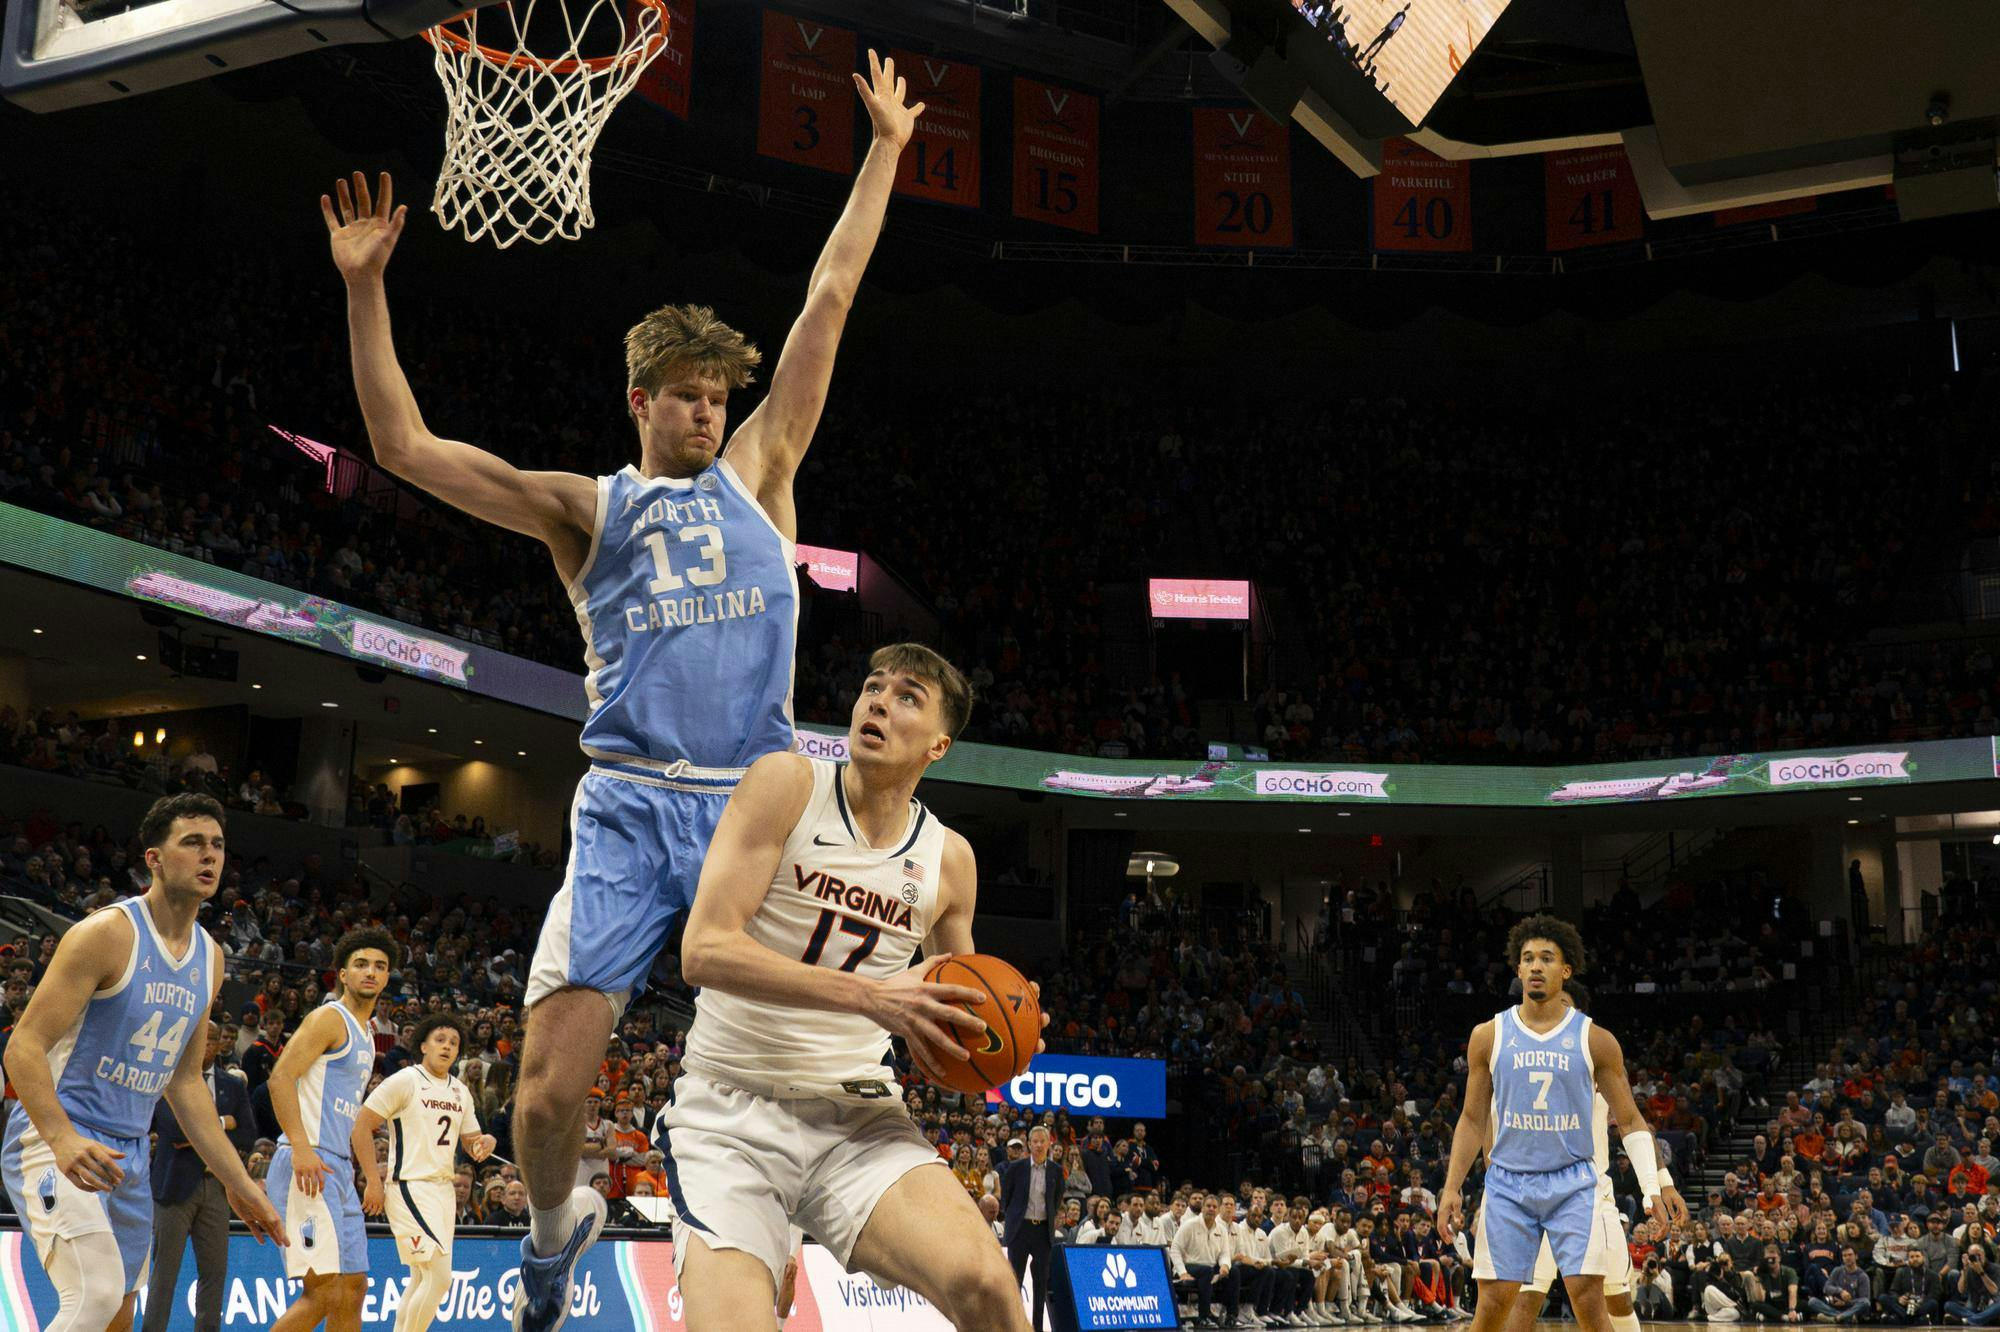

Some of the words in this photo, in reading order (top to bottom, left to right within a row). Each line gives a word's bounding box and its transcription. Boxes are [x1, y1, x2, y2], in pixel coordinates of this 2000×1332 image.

[791, 83, 826, 101] LAMP
[794, 106, 819, 151] 3
[914, 119, 969, 141] ILKINSON
[912, 140, 959, 192] 14
[1029, 144, 1086, 168] BROGDON
[1033, 166, 1076, 214] 15
[1223, 172, 1262, 184] STITH
[1391, 176, 1454, 190] PARKHILL
[1567, 168, 1617, 185] WALKER
[1216, 191, 1273, 234] 20
[1391, 196, 1452, 240] 40
[1567, 190, 1615, 234] 41
[628, 498, 725, 538] NORTH
[643, 524, 727, 595] 13
[819, 562, 852, 577] Teeter
[625, 586, 767, 632] CAROLINA
[1174, 593, 1207, 604] Harris
[1208, 594, 1244, 605] Teeter
[1265, 776, 1374, 795] GOCHO.com
[1778, 761, 1893, 781] GOCHO.com
[794, 863, 913, 932] VIRGINIA
[801, 908, 882, 973] 17
[143, 982, 196, 1015] NORTH
[129, 1010, 189, 1067] 44
[96, 1055, 176, 1094] CAROLIN
[1512, 1050, 1570, 1072] NORTH
[421, 1098, 464, 1114] VIRGINIA
[1528, 1071, 1554, 1111] 7
[437, 1115, 452, 1146] 2
[1503, 1110, 1581, 1131] CAROLINA
[436, 1267, 496, 1322] The
[1088, 1295, 1108, 1311] UVA
[1107, 1295, 1159, 1312] COMMUNITY
[1092, 1314, 1127, 1325] CREDIT
[1132, 1313, 1162, 1325] UNION
